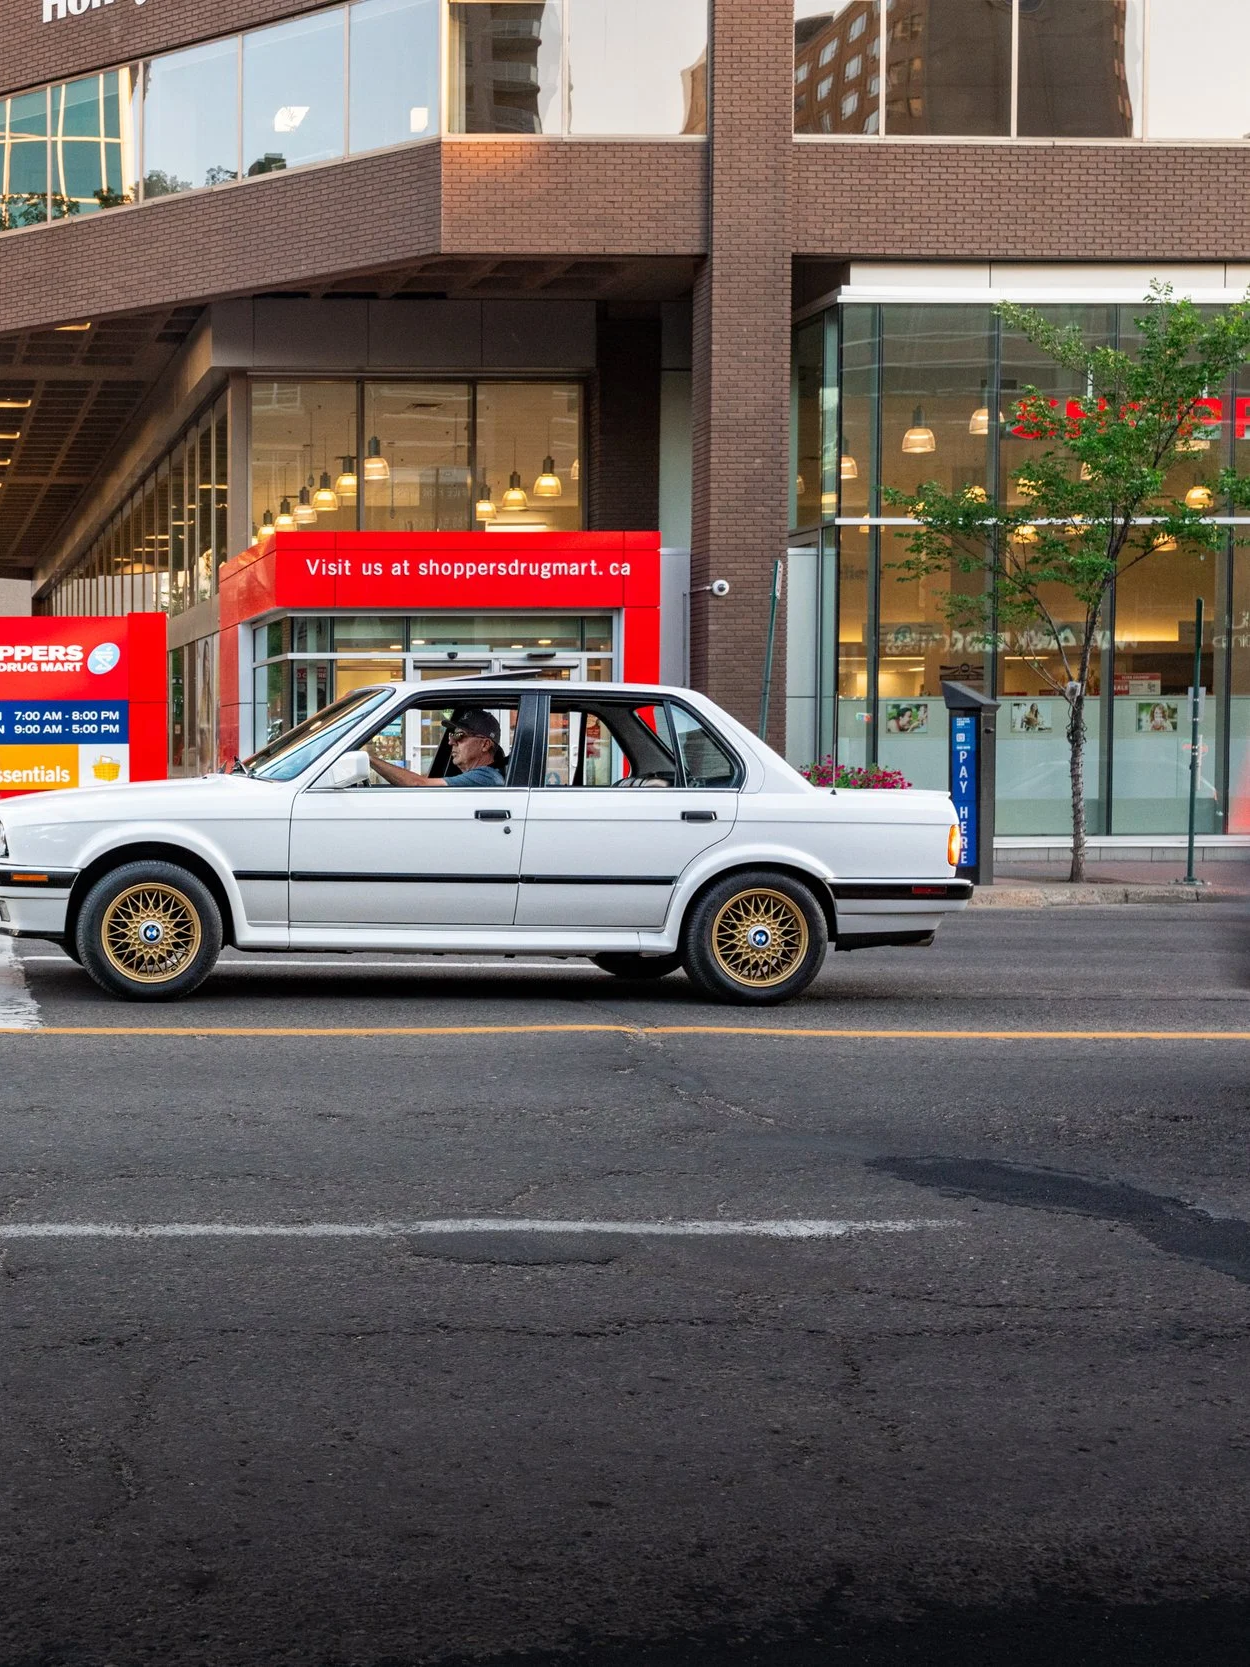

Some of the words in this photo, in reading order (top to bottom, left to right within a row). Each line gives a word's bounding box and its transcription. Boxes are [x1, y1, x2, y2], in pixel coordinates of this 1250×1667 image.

[305, 559, 351, 576] Visit
[361, 562, 383, 576] us
[391, 559, 410, 576] at
[41, 662, 83, 672] MART
[14, 711, 40, 721] 7:00
[42, 711, 62, 721] AM
[71, 711, 98, 721] 8:00
[100, 711, 119, 720] PM
[14, 724, 40, 734] 9:00
[42, 724, 62, 734] AM
[71, 724, 98, 734] 5:00
[100, 724, 119, 734] PM
[959, 750, 969, 794] PAY
[959, 806, 969, 864] HERE
